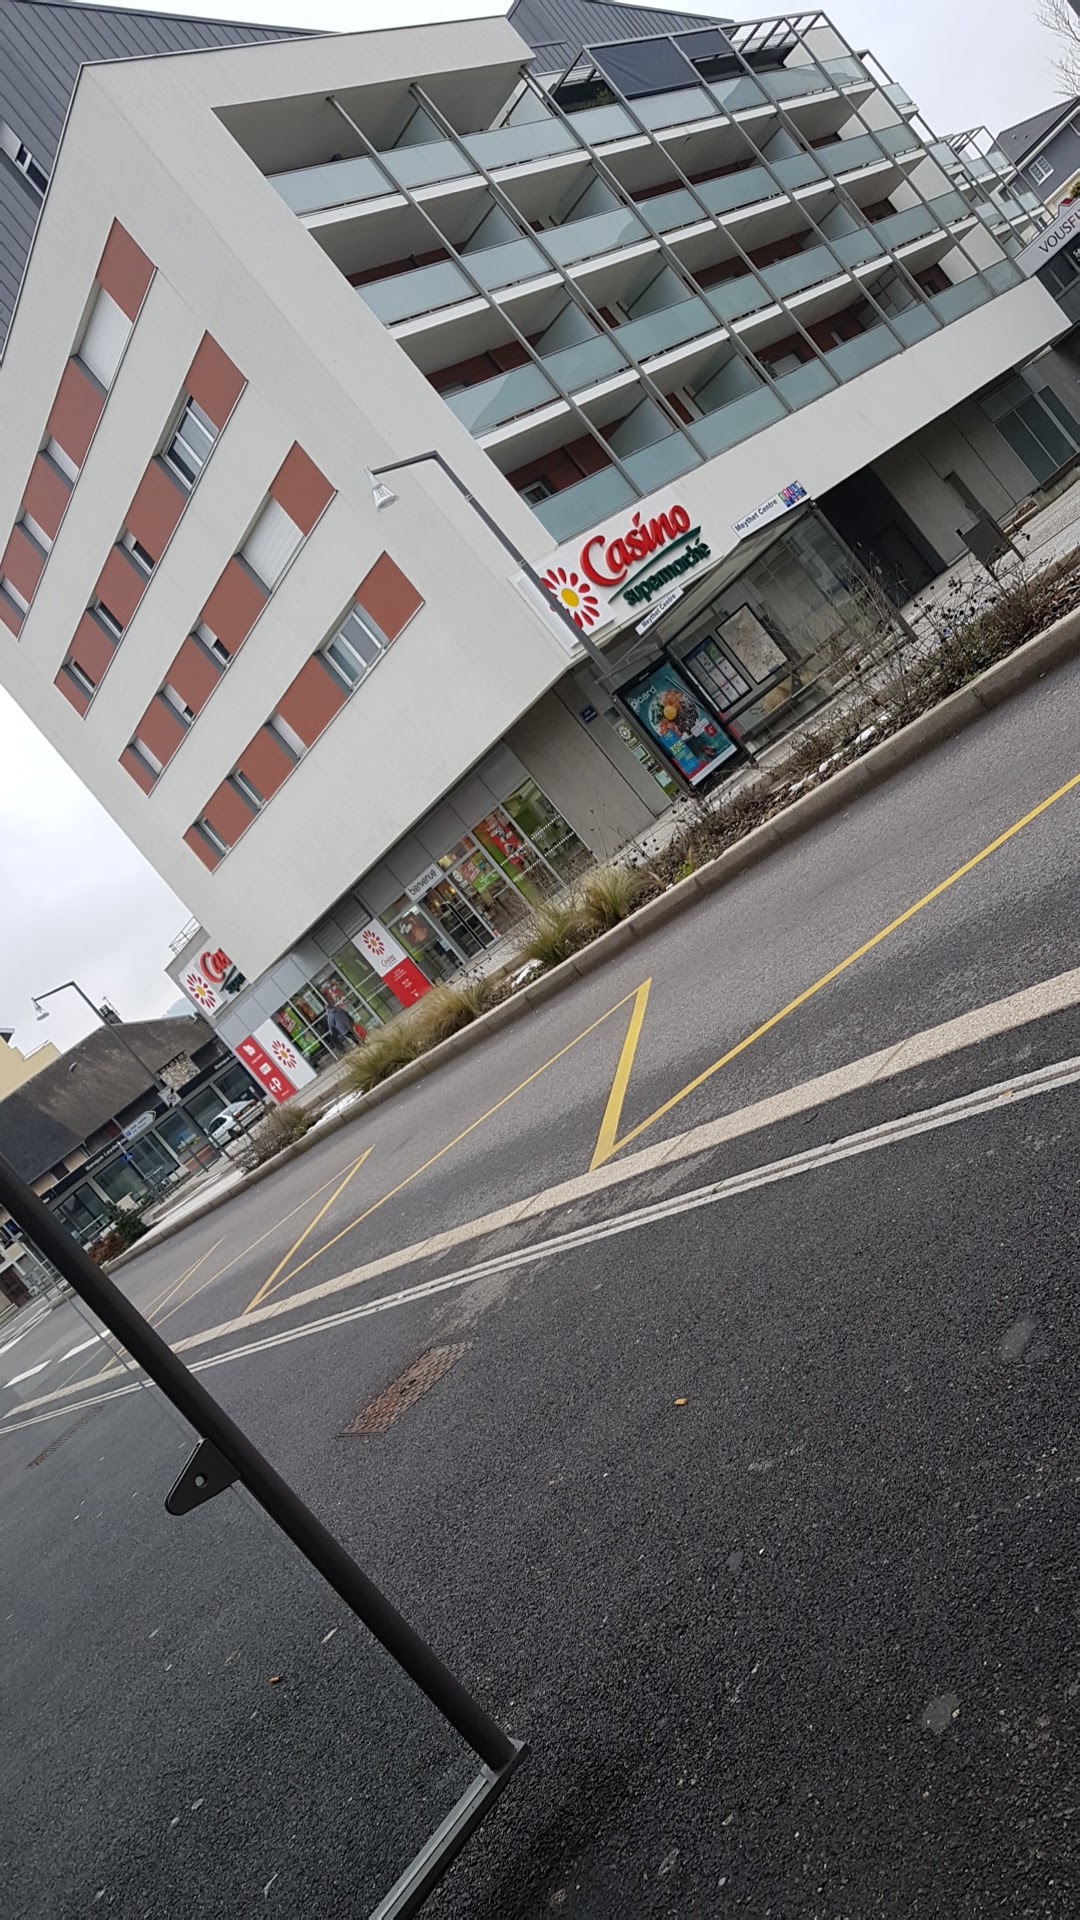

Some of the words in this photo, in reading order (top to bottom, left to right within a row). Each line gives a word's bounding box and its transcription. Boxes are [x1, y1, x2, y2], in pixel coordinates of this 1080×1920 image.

[735, 511, 760, 533] Meythet
[758, 498, 778, 518] Centre
[580, 505, 690, 586] Casino
[623, 537, 711, 606] supermarché
[641, 606, 661, 629] Meythet
[658, 592, 676, 612] Centre
[630, 685, 657, 710] picard
[408, 868, 437, 896] bienvenue
